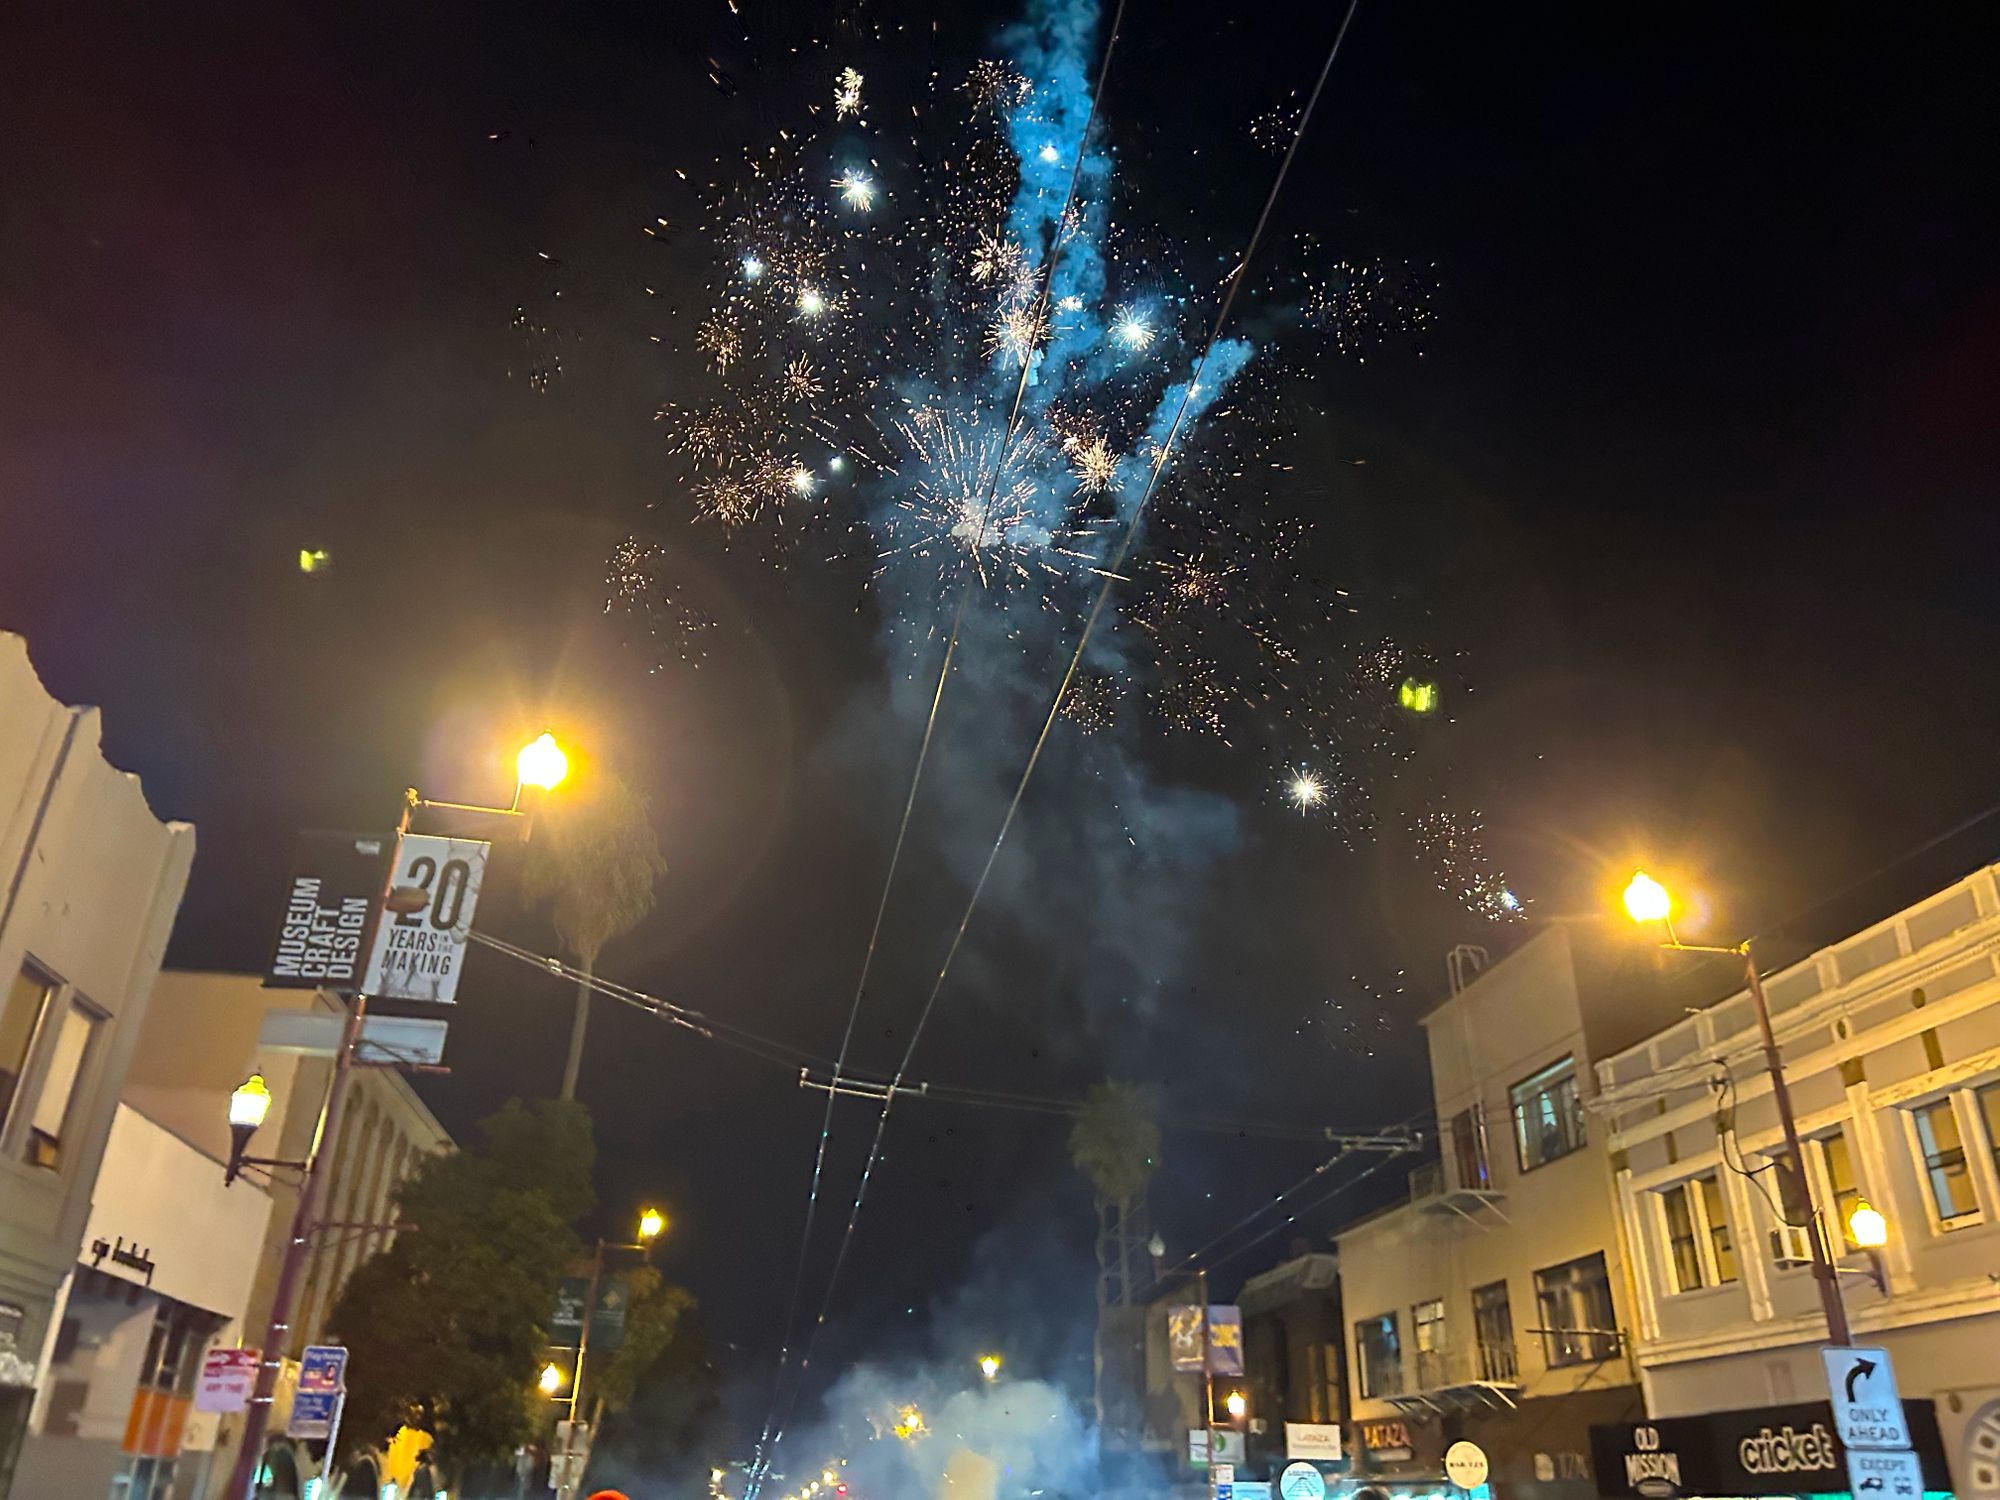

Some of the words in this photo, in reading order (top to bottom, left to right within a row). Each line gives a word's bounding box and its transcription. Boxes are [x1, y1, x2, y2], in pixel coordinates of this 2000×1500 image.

[394, 856, 470, 931] 20
[273, 877, 322, 976] MUSEUM
[300, 905, 340, 978] CRAFT
[326, 897, 369, 979] DESIGN
[388, 928, 438, 952] YEARS
[381, 949, 452, 976] MAKING
[1848, 1408, 1889, 1423] ONLY
[1634, 1426, 1661, 1451] OLD
[1740, 1422, 1837, 1475] cricket
[1848, 1426, 1900, 1442] AHEAD
[1625, 1453, 1682, 1488] MISSION
[1858, 1457, 1907, 1472] EXCEPT
